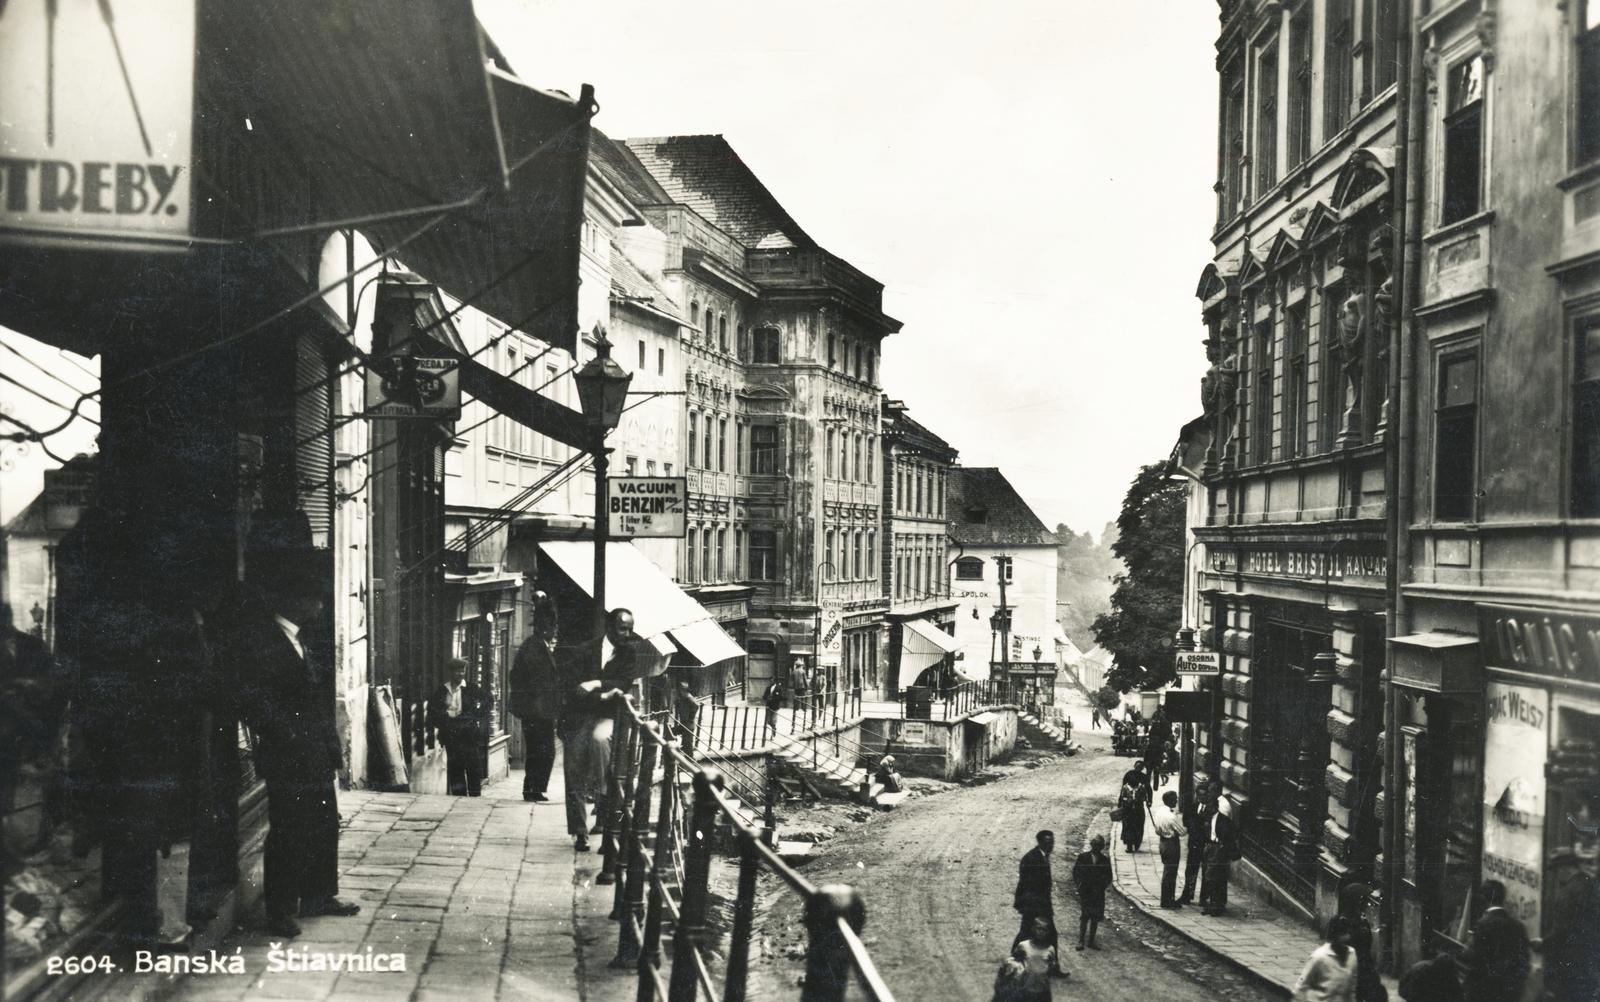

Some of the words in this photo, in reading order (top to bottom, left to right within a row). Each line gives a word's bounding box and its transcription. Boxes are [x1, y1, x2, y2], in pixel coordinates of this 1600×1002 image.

[0, 158, 179, 216] TREBY.
[618, 482, 676, 495] VACUUM
[610, 496, 665, 514] BENZIN
[619, 515, 624, 524] 1
[619, 524, 624, 533] 1
[1250, 552, 1281, 573] HOTEL
